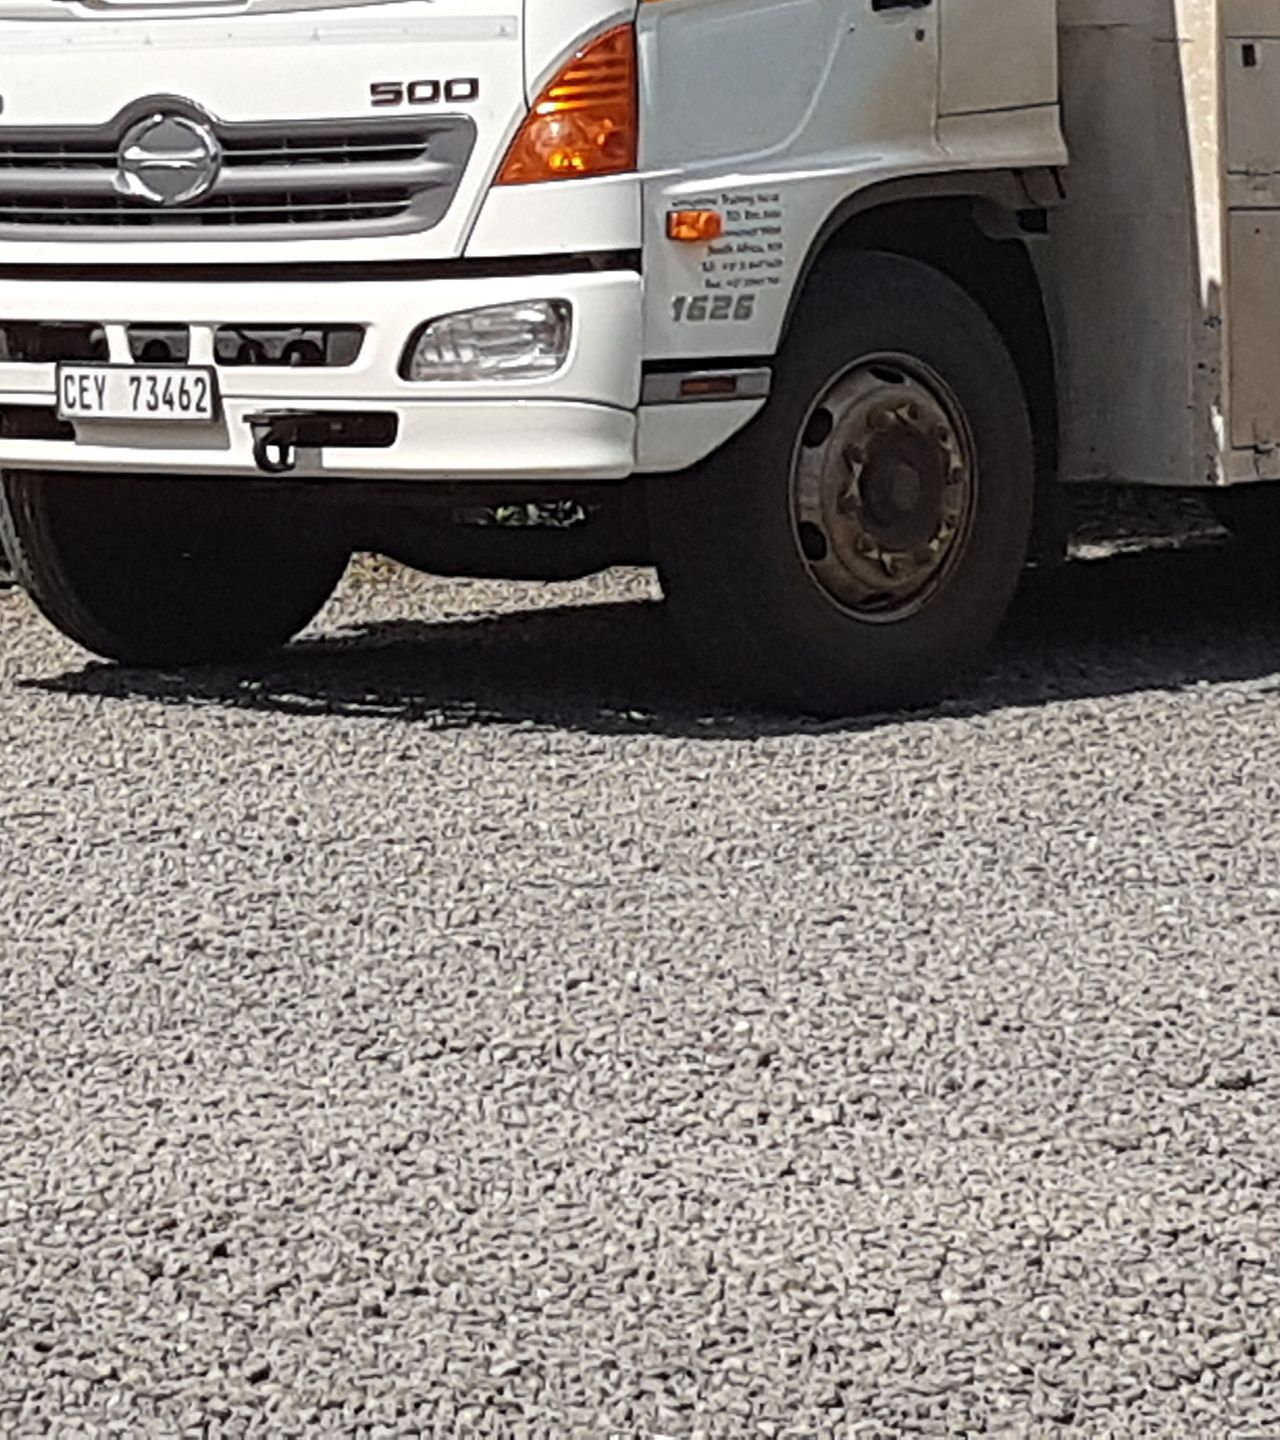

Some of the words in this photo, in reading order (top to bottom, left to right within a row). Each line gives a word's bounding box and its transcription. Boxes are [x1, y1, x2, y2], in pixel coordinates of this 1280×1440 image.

[369, 78, 480, 107] 500
[671, 293, 755, 322] 1626
[63, 373, 106, 412] CEY
[129, 375, 209, 414] 73462
